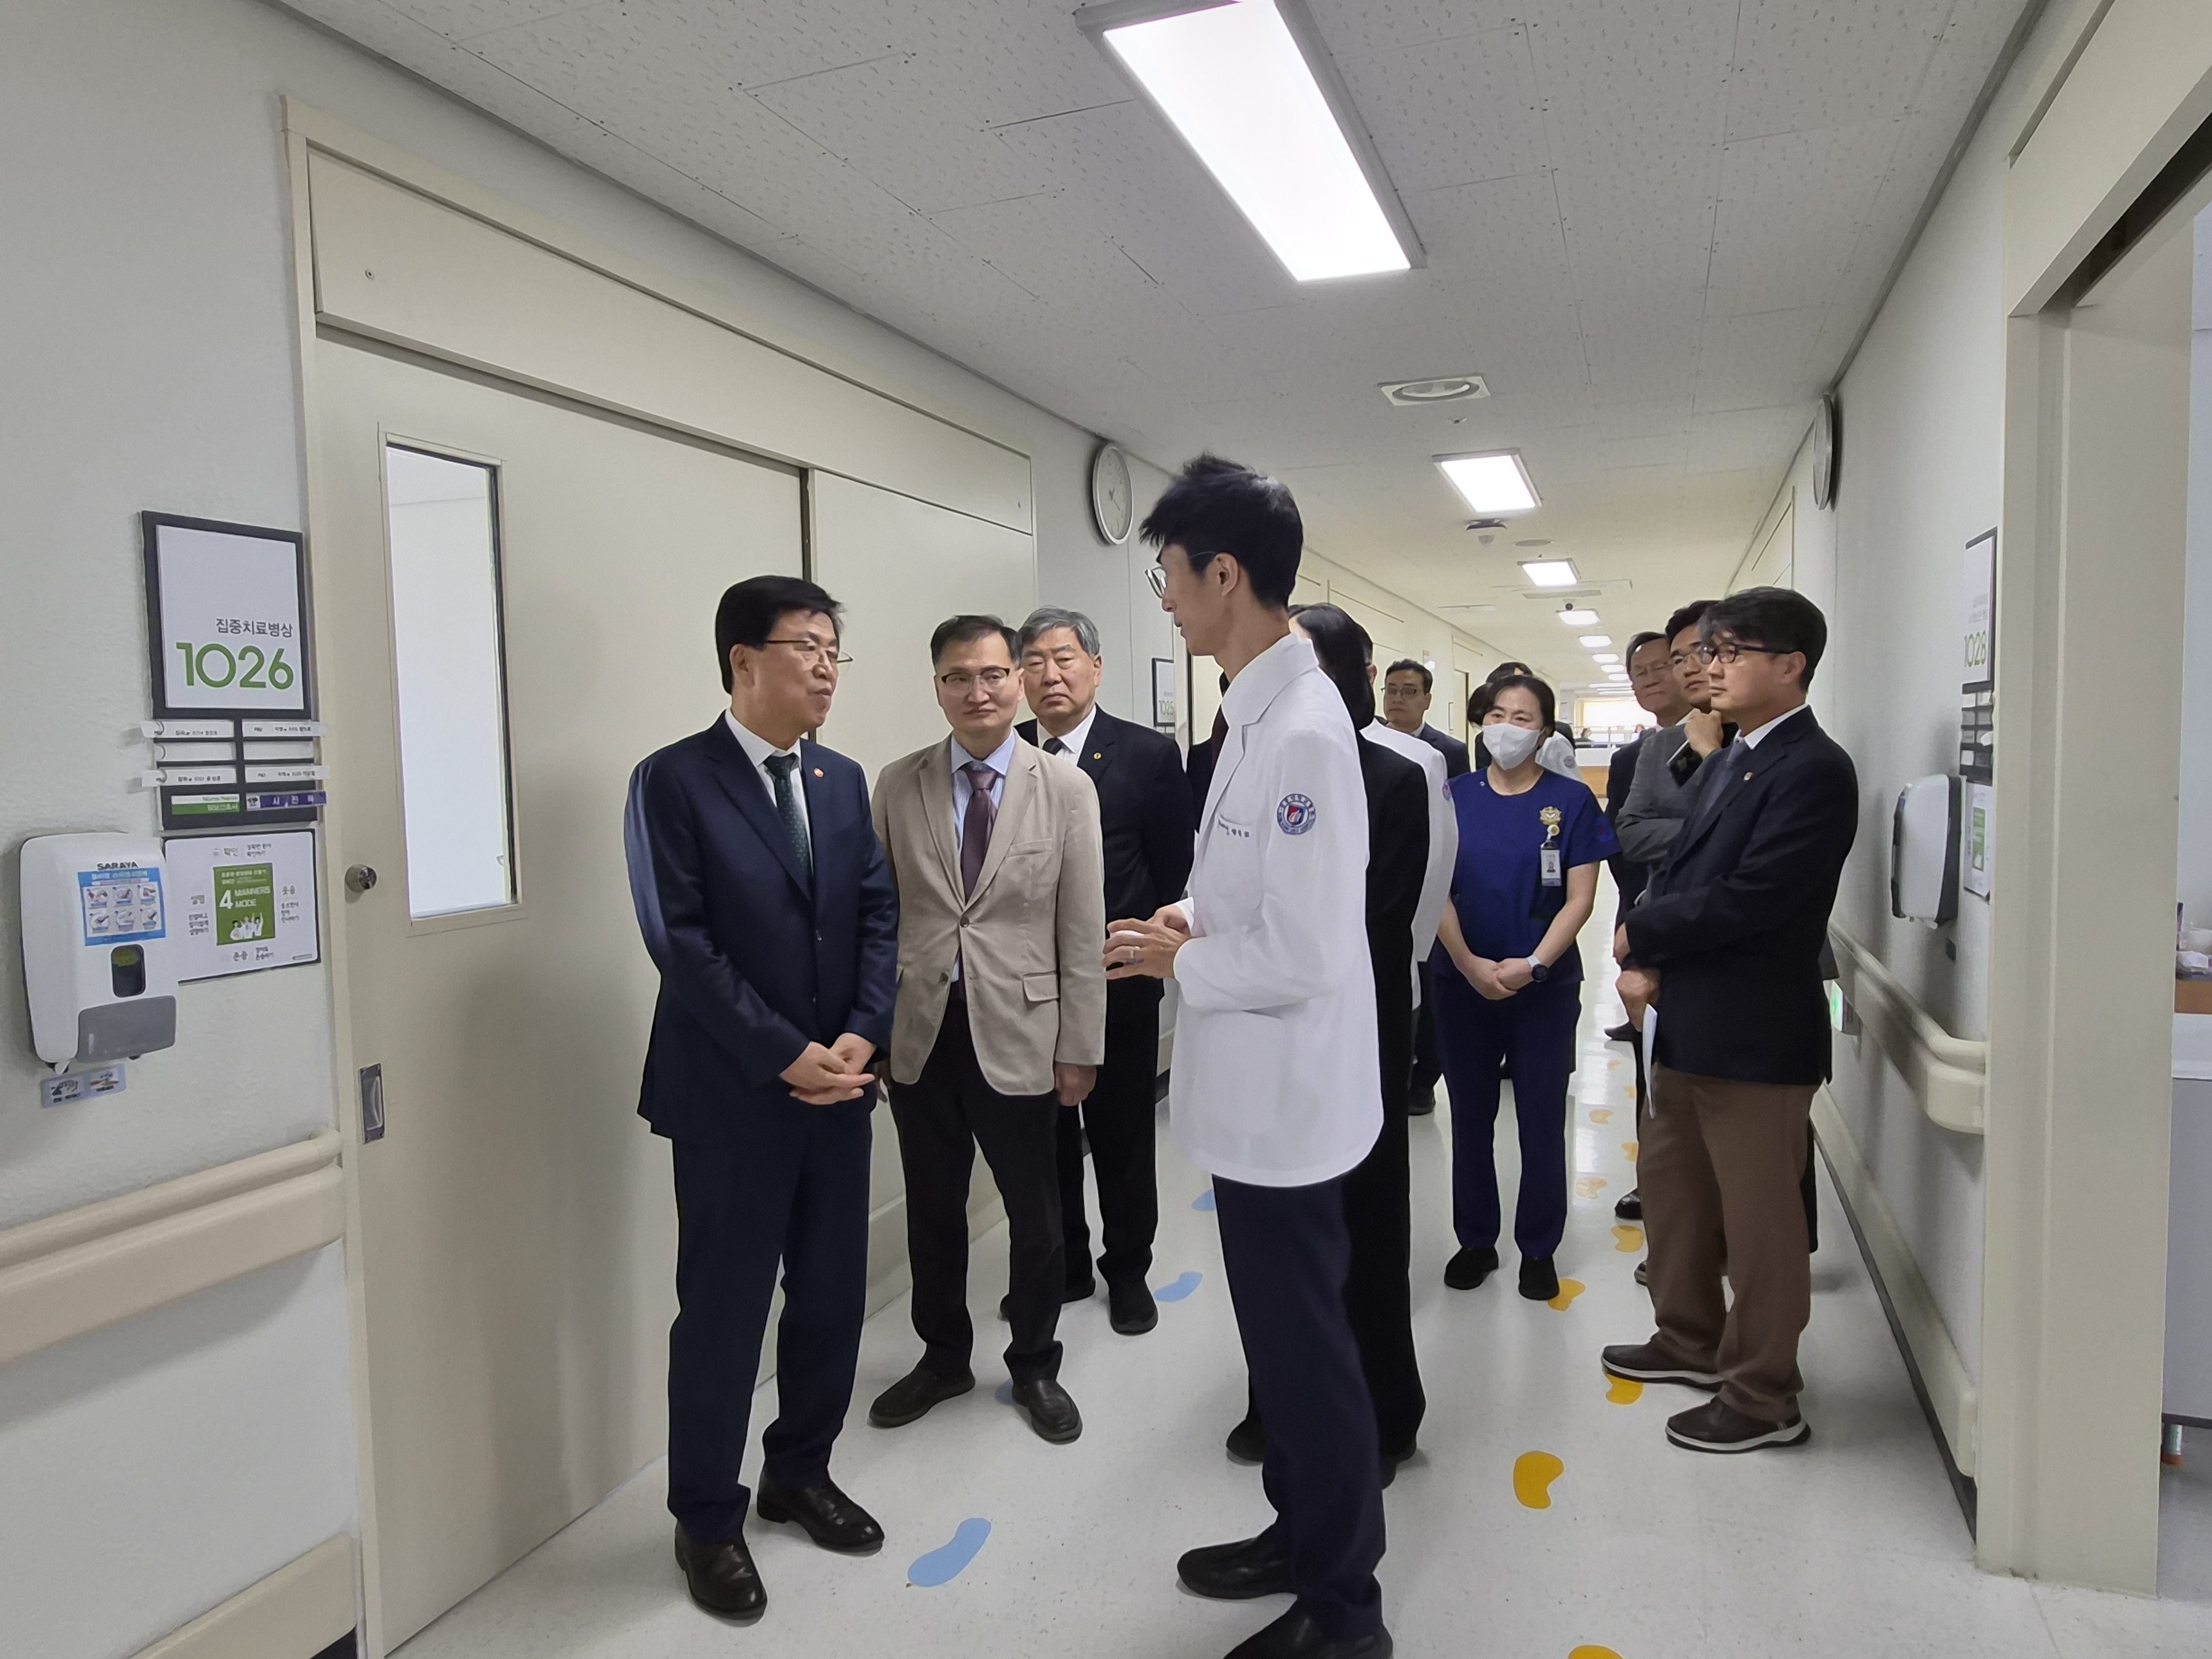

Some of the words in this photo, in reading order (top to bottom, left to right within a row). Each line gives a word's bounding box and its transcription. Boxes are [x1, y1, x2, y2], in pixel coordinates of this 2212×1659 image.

[216, 618, 293, 638] 집중치료병상
[1964, 630, 1986, 667] 1028
[176, 641, 294, 690] 1026
[97, 862, 138, 870] SARAYA
[219, 889, 233, 910] 4
[235, 898, 257, 908] MODE
